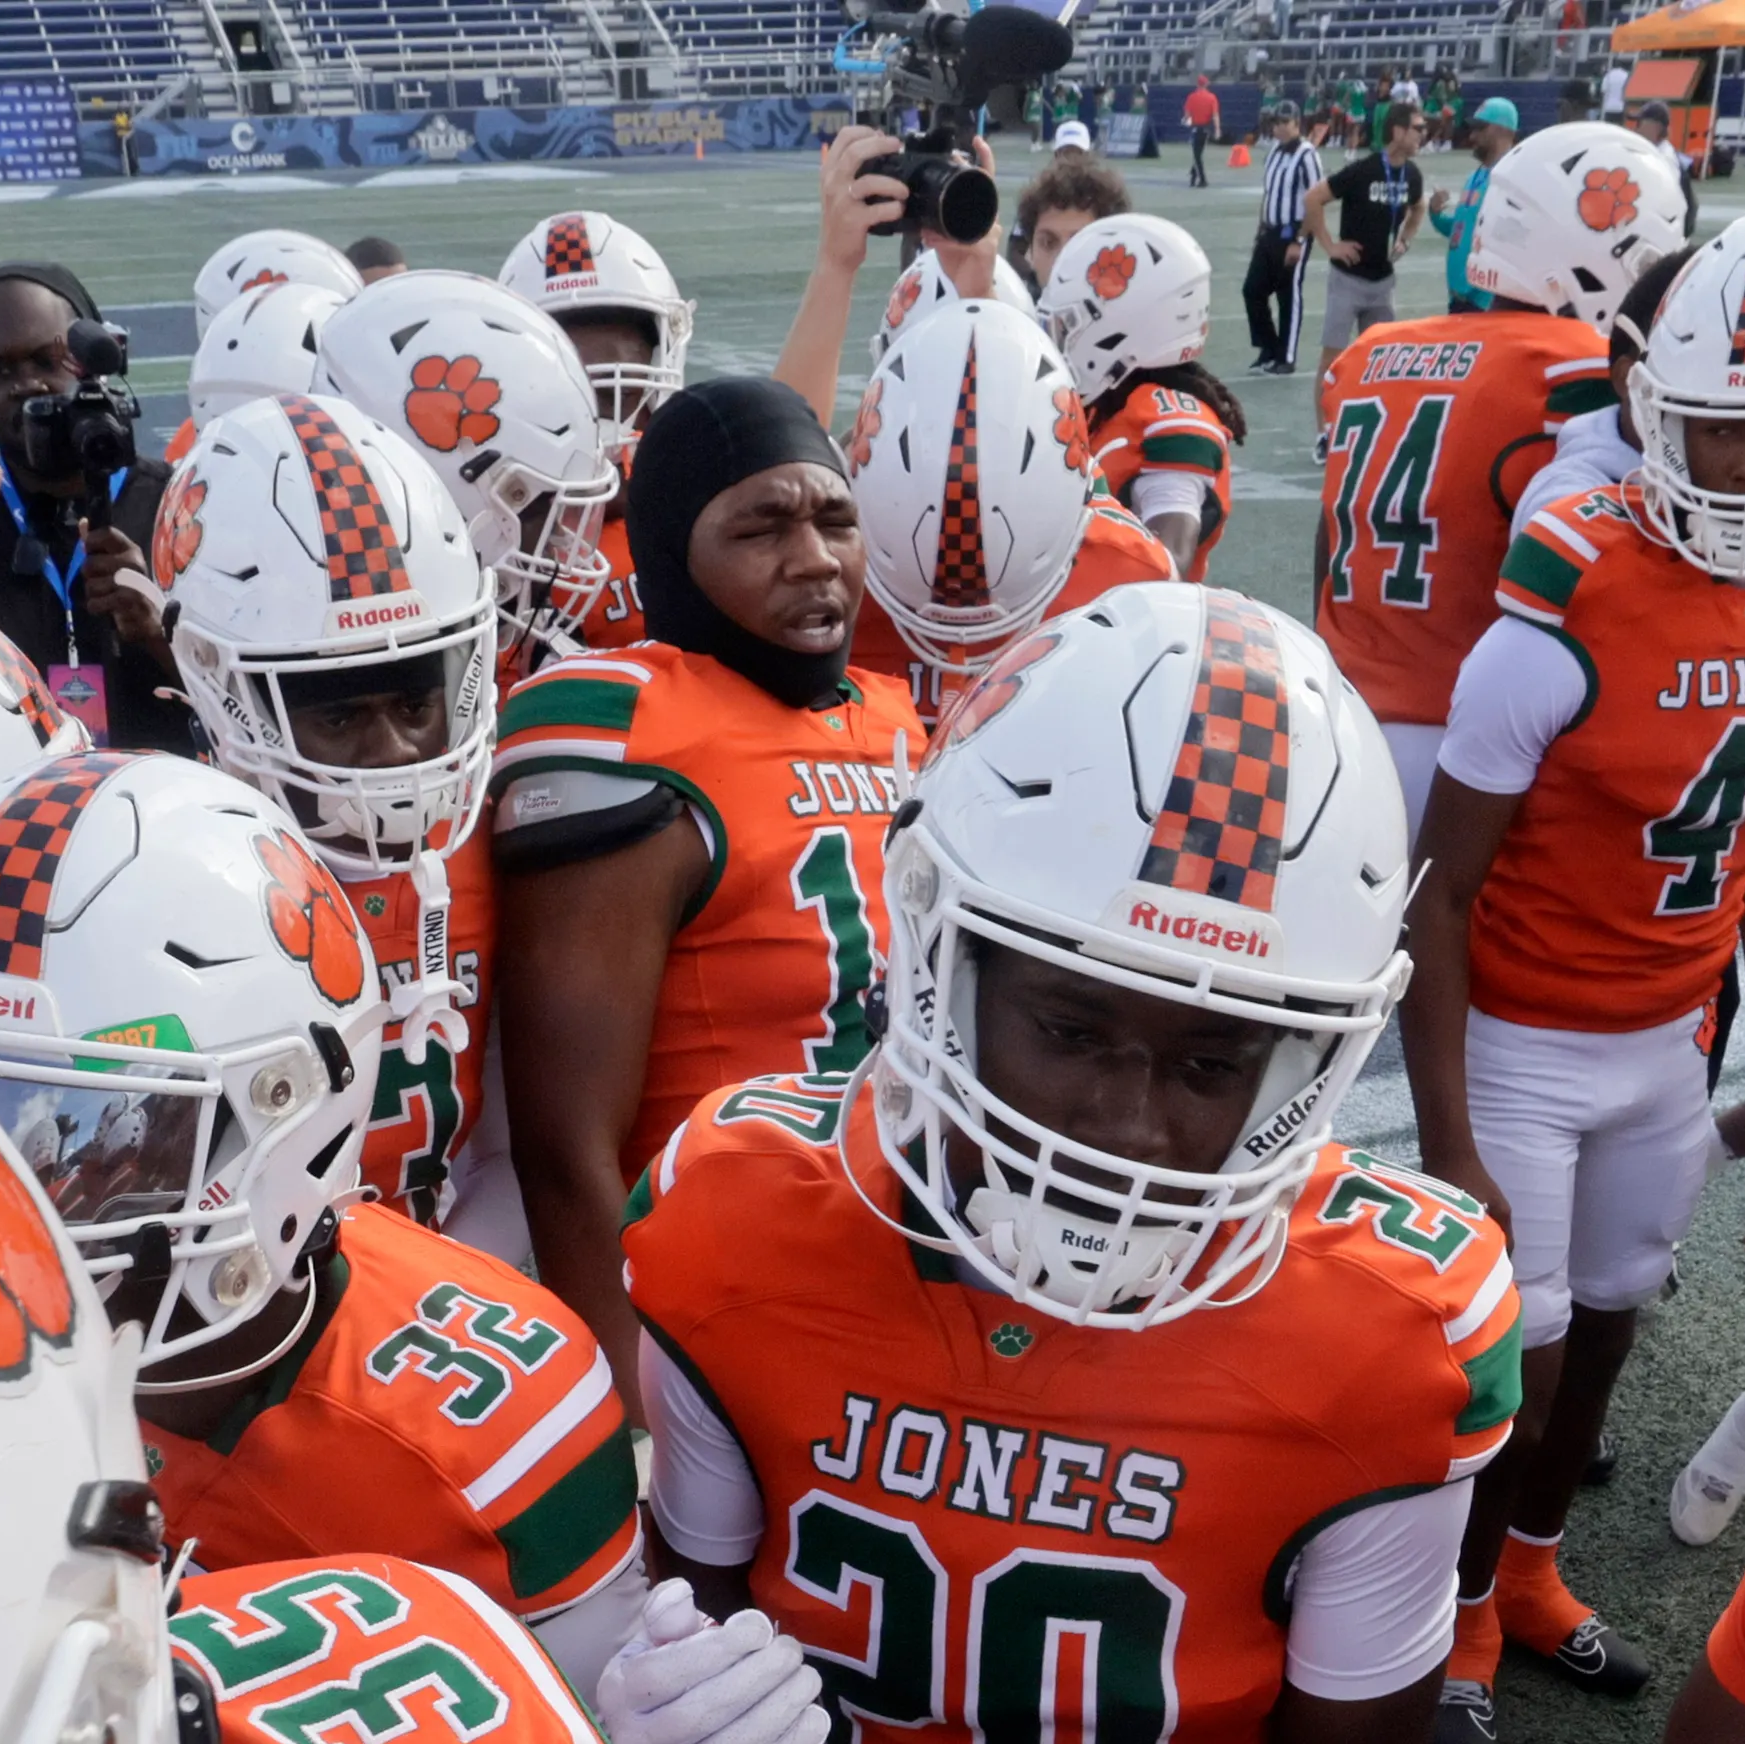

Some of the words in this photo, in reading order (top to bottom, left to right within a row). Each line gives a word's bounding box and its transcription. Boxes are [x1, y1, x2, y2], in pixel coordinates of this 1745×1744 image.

[208, 155, 249, 170] OCEAN
[251, 153, 287, 168] BANK
[417, 131, 467, 150] TEXAS
[544, 274, 598, 293] Riddell
[1360, 341, 1483, 386] TIGERS
[1149, 387, 1200, 417] 16
[1329, 394, 1455, 610] 74
[337, 602, 421, 631] Riddell
[455, 653, 485, 720] Riddell
[786, 760, 916, 819] JONE
[425, 909, 446, 975] NXTRND
[1130, 899, 1270, 959] Riddell
[1060, 1228, 1129, 1258] Riddl
[365, 1281, 569, 1427] 32
[812, 1390, 1185, 1546] JONES
